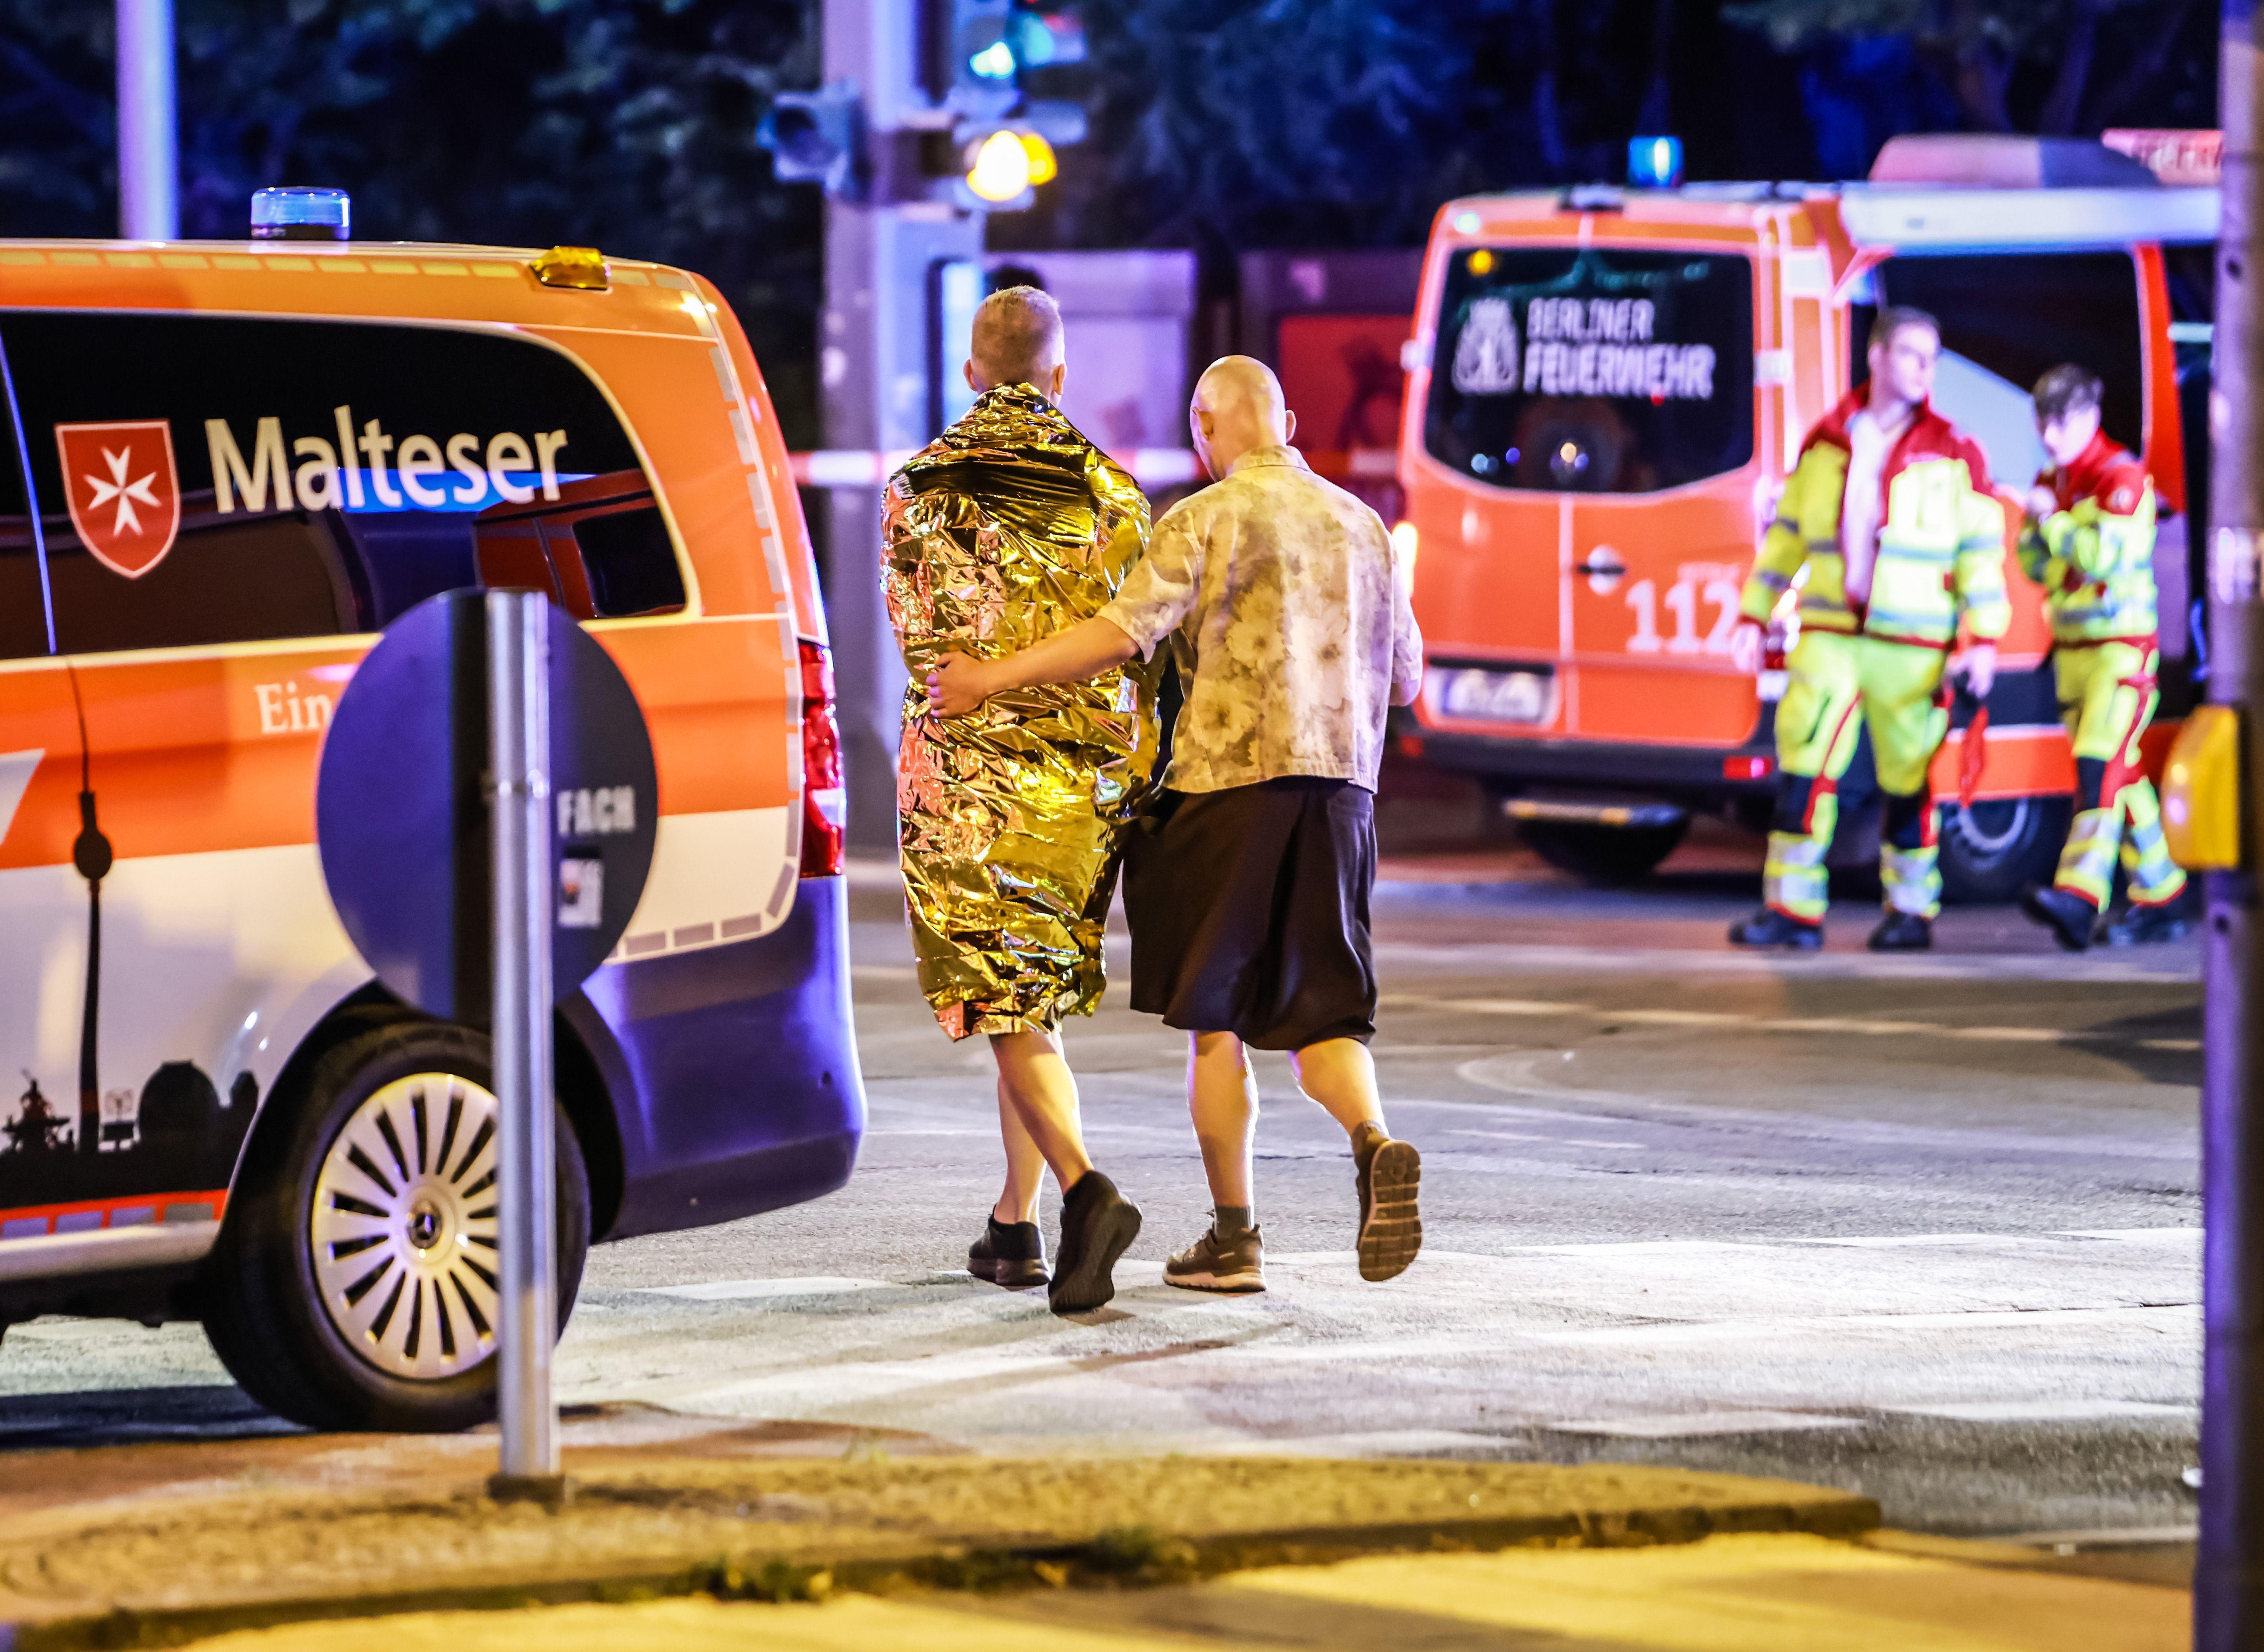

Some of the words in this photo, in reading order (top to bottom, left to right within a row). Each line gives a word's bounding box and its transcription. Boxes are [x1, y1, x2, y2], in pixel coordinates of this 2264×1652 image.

[1527, 297, 1655, 340] BERLINER
[1523, 342, 1717, 400] FEUERWEHR
[204, 405, 567, 514] Malteser
[1625, 579, 1741, 653] 112
